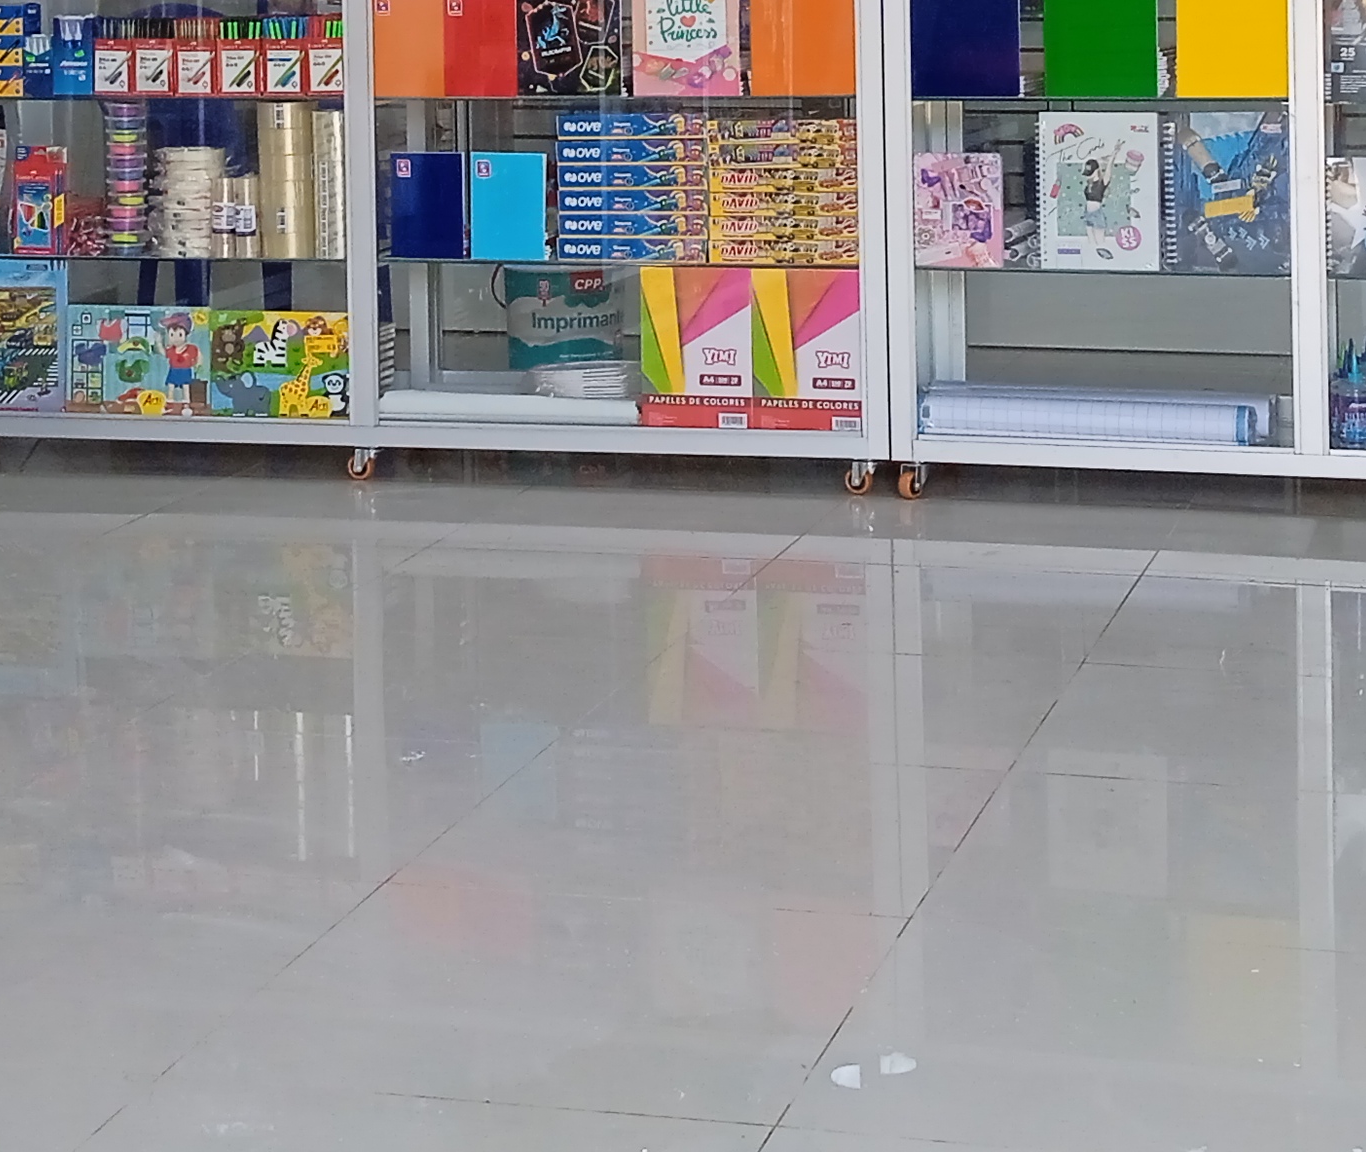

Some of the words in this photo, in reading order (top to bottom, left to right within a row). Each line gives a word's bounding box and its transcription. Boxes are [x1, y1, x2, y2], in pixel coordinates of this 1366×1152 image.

[657, 16, 718, 43] Princess
[1340, 47, 1356, 57] 25
[721, 173, 758, 184] DAVID
[721, 198, 759, 209] DAVID
[721, 222, 758, 232] DAVID
[721, 246, 758, 257] DAVID
[702, 348, 737, 365] YIMI
[815, 351, 851, 369] YIMI
[649, 395, 686, 405] PAPELES
[689, 397, 701, 406] DE
[703, 397, 745, 407] COLORES
[761, 399, 799, 408] PAPELES
[801, 400, 814, 409] DE
[817, 401, 859, 410] COLORES
